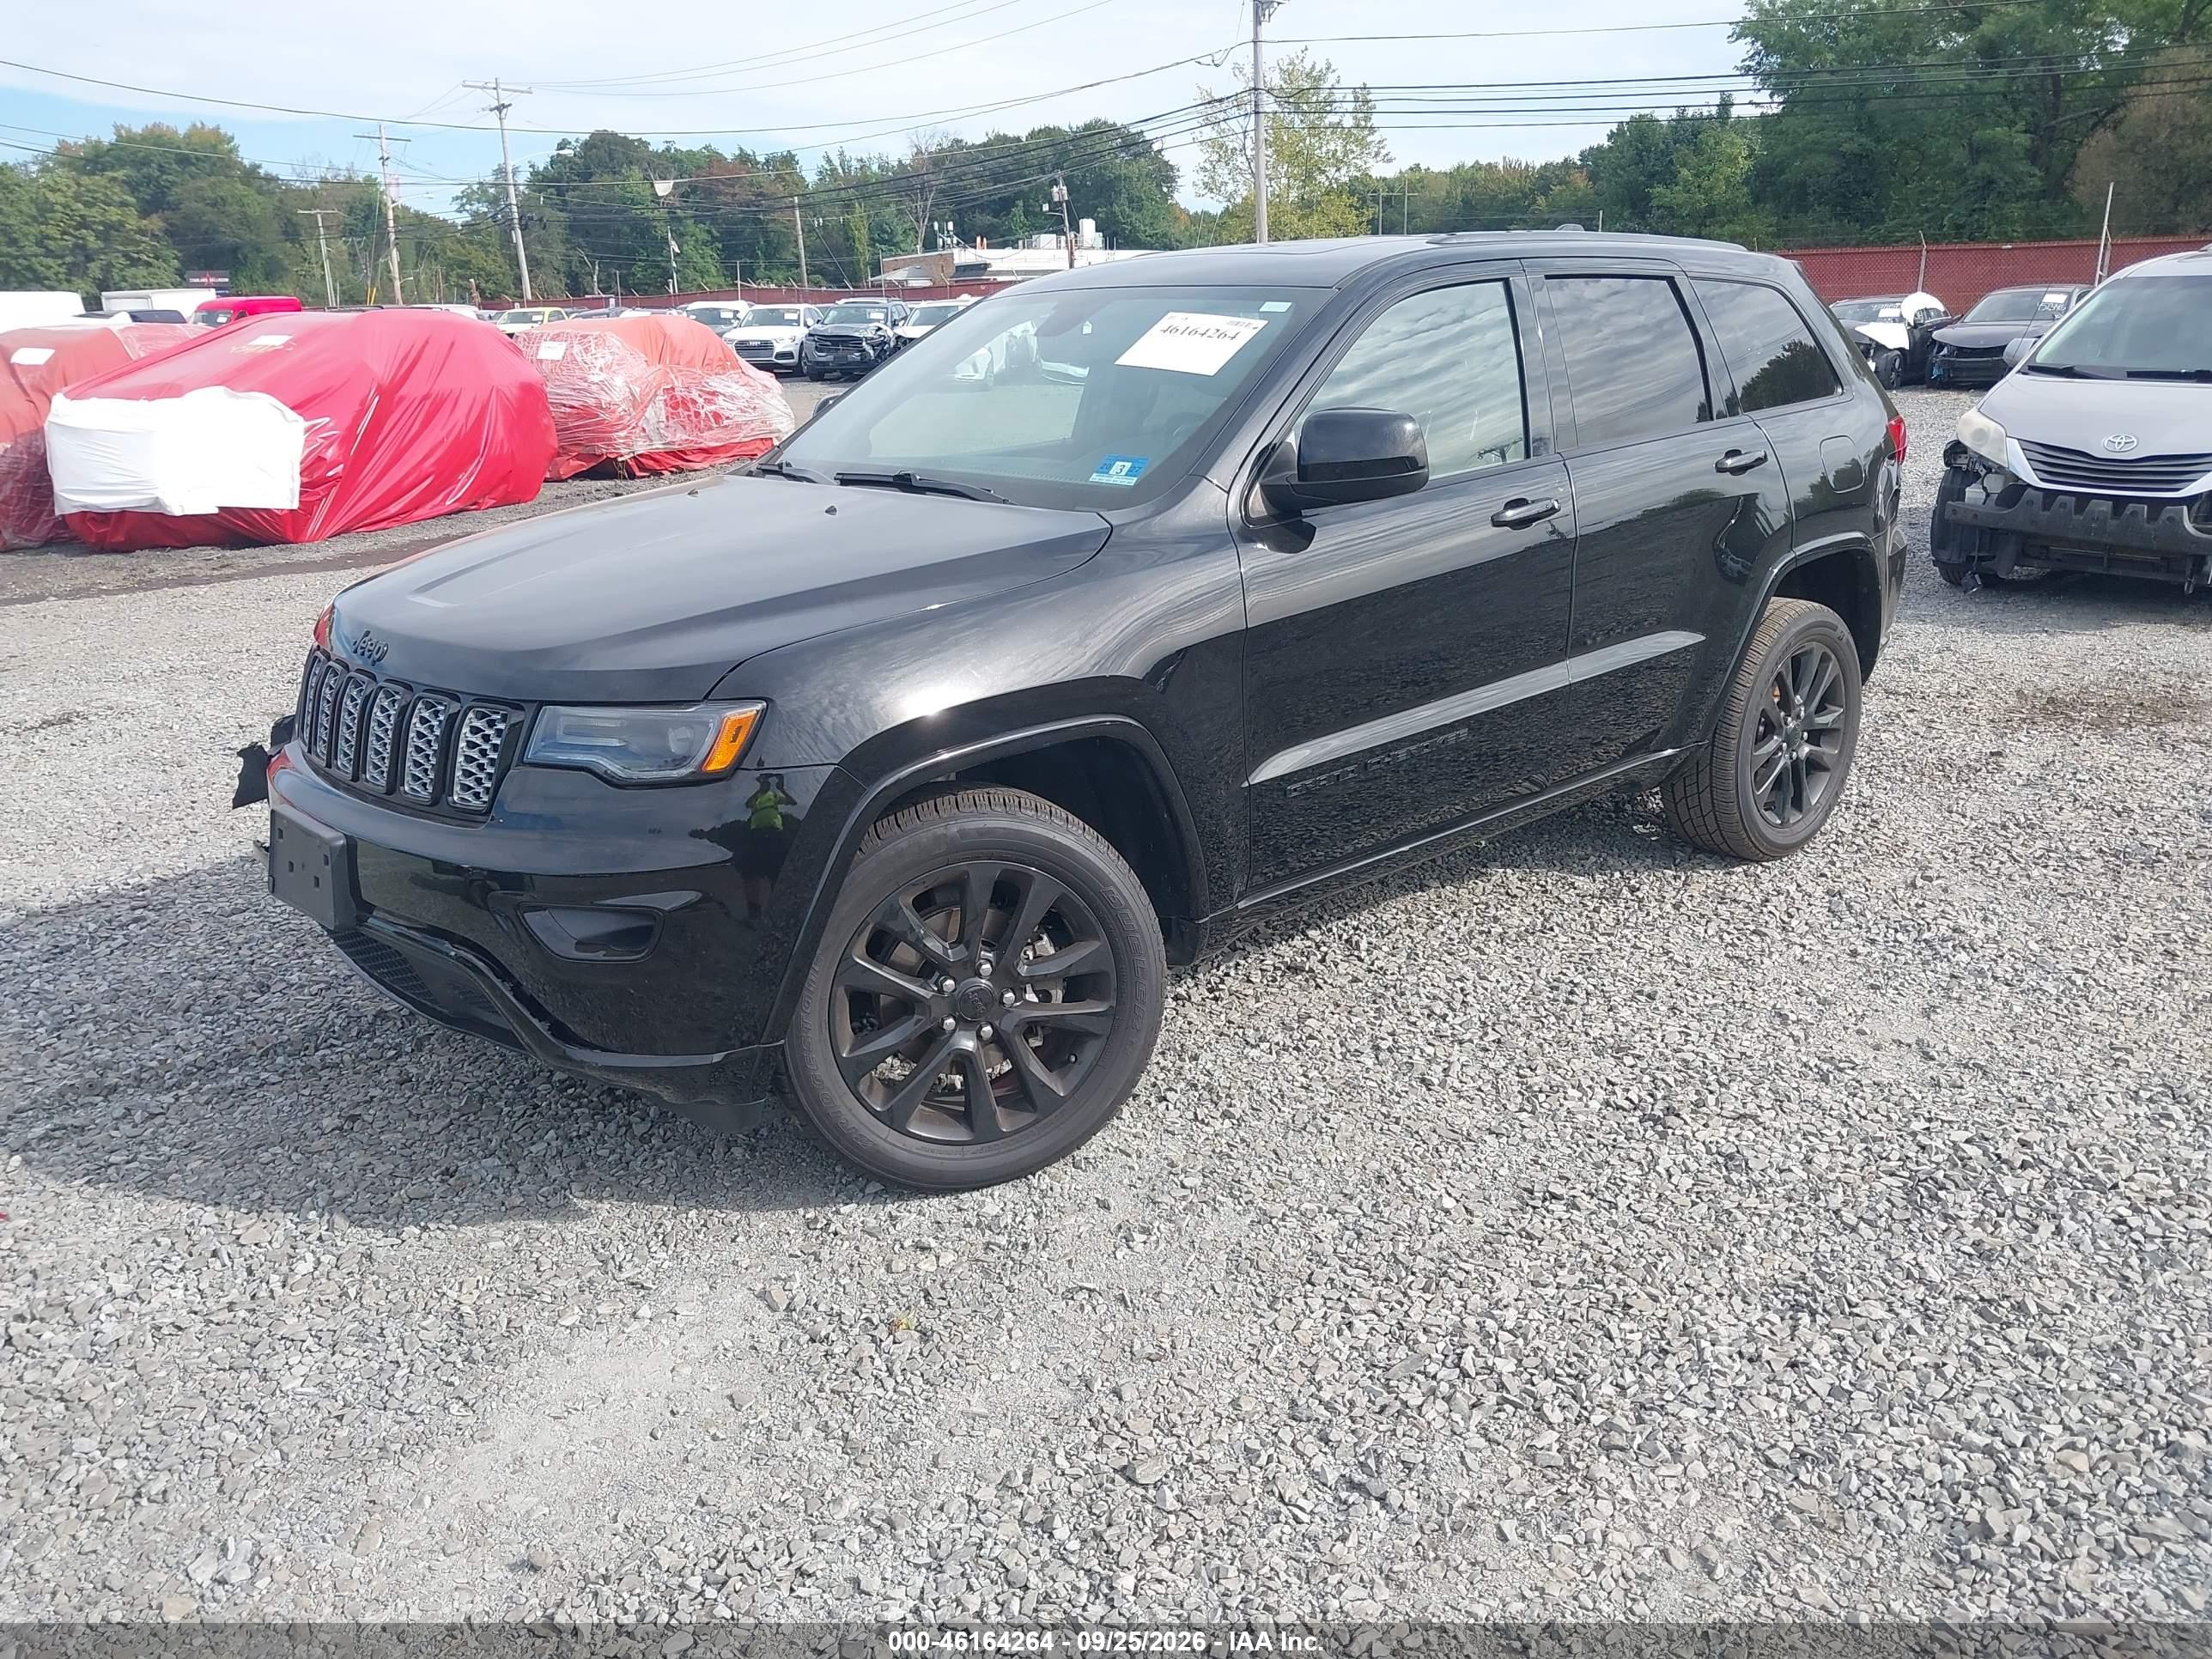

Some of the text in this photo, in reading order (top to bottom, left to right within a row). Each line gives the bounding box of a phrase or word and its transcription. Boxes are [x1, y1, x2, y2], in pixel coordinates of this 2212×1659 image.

[1160, 325, 1242, 341] 46164264
[1115, 465, 1126, 475] 3
[352, 629, 389, 666] Jeep
[1099, 885, 1148, 1030] DUELER
